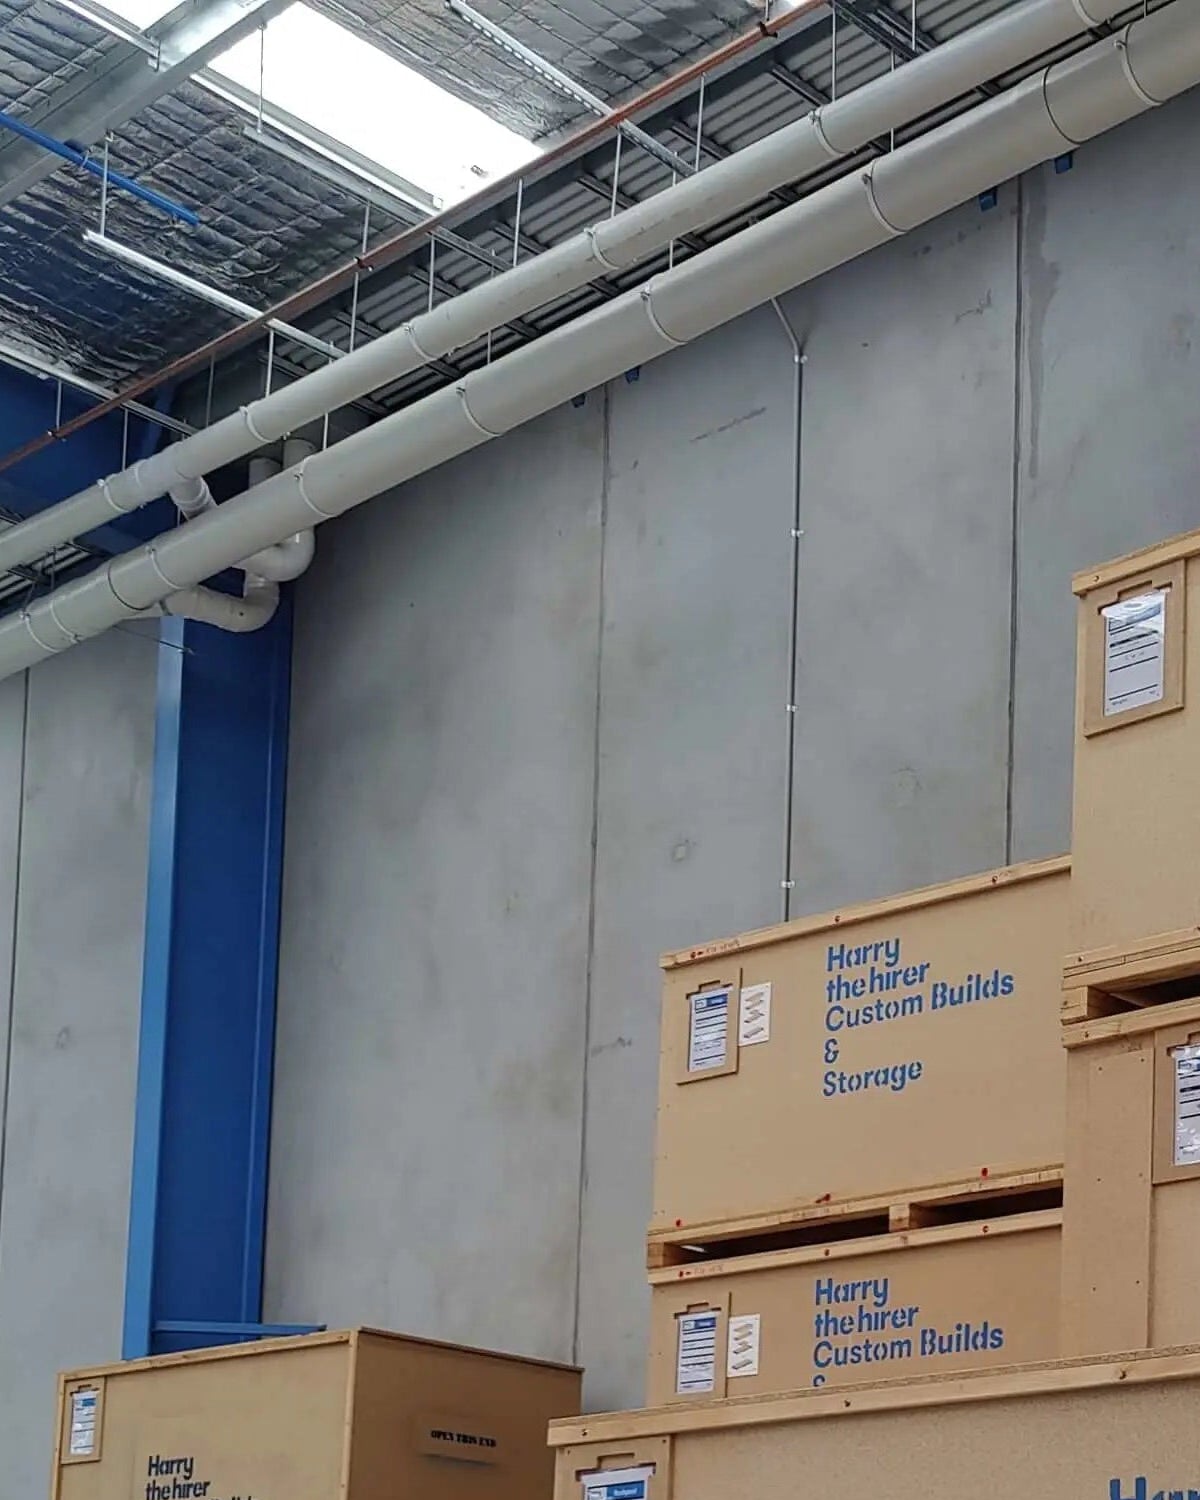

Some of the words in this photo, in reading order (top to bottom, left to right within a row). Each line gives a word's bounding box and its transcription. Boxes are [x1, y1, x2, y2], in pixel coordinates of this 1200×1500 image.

[827, 939, 900, 971] Harry
[825, 994, 923, 1031] Custom
[931, 970, 1014, 1010] Builds
[824, 1038, 839, 1064] &
[823, 1061, 922, 1096] Storage
[815, 1278, 889, 1307] Harry
[813, 1339, 912, 1368] Custom
[920, 1321, 1004, 1356] Builds
[148, 1454, 194, 1480] Harry
